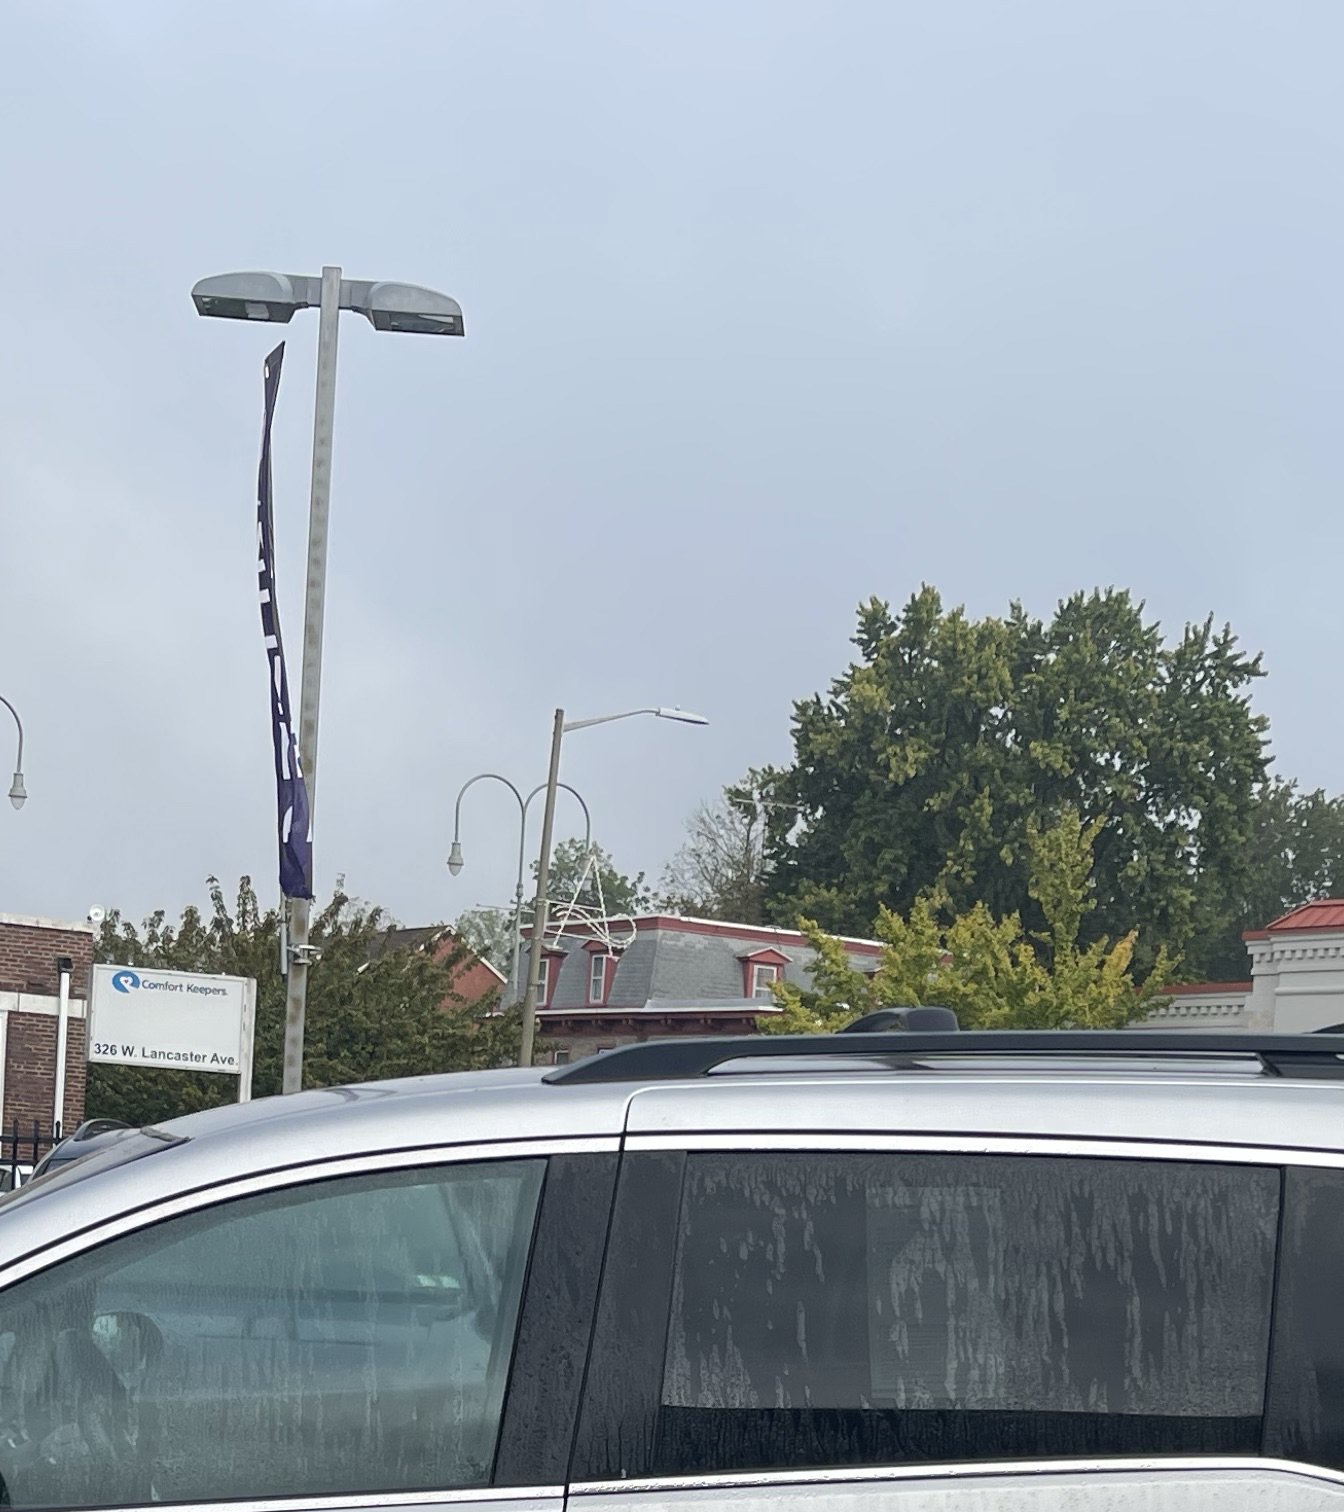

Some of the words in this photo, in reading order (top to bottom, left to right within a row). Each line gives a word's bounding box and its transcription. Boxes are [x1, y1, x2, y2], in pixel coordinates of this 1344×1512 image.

[141, 980, 183, 993] Comfort
[94, 1043, 117, 1056] 326
[121, 1045, 138, 1058] W.
[141, 1047, 207, 1063] Lancaster
[210, 1052, 239, 1066] Ave.
